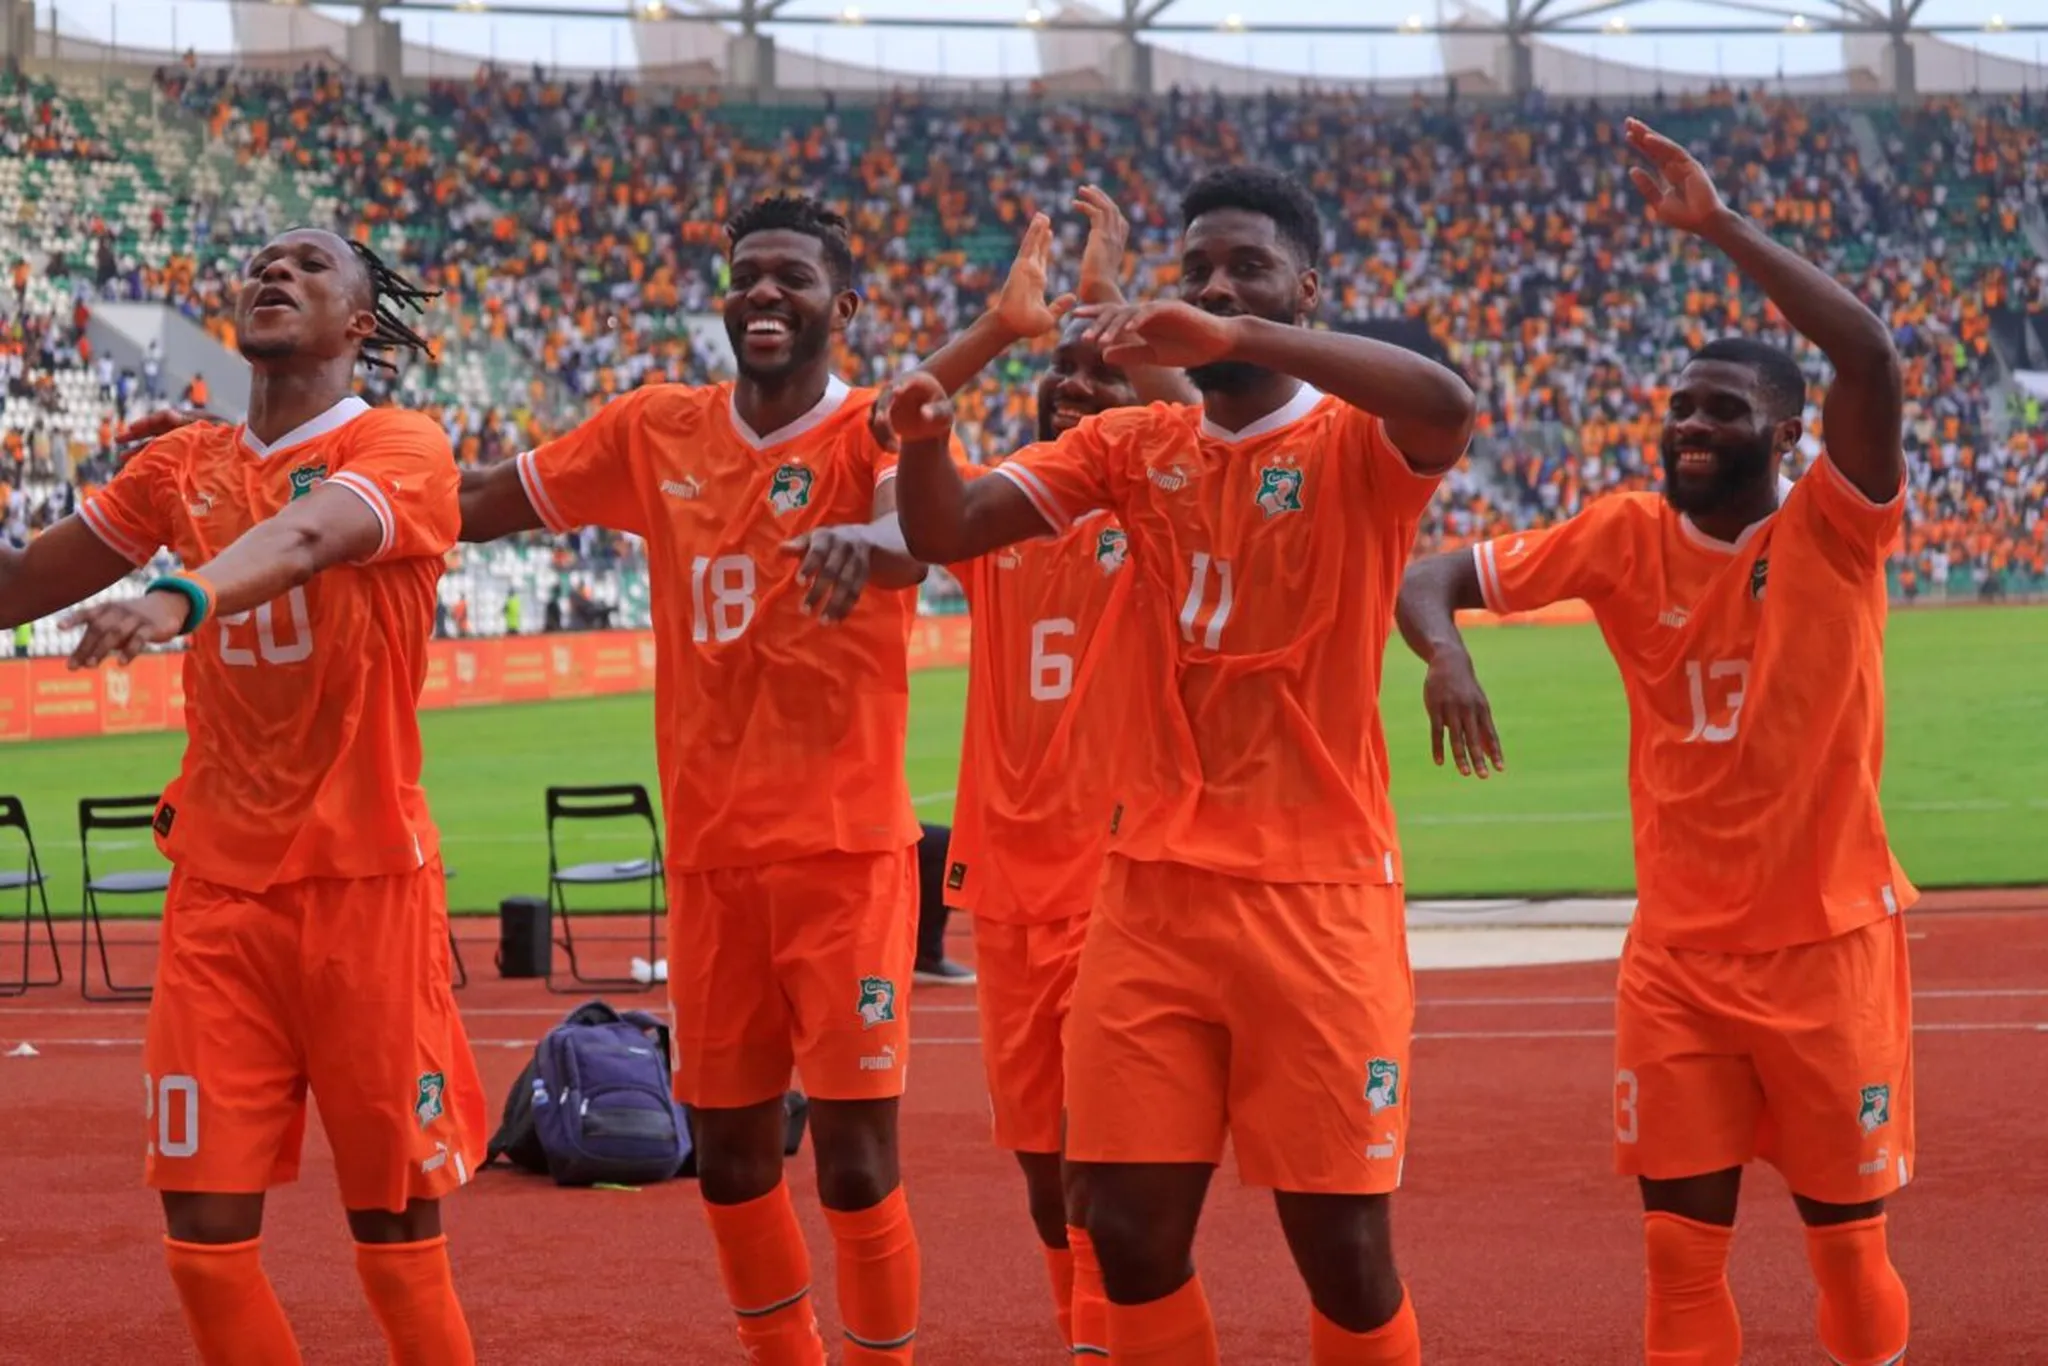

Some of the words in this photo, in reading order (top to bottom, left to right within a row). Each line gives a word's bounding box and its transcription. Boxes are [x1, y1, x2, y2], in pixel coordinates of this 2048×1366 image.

[692, 554, 756, 644] 18
[1179, 551, 1233, 652] 11
[1030, 617, 1075, 701] 6
[1681, 659, 1750, 743] 13
[145, 1073, 199, 1158] 0
